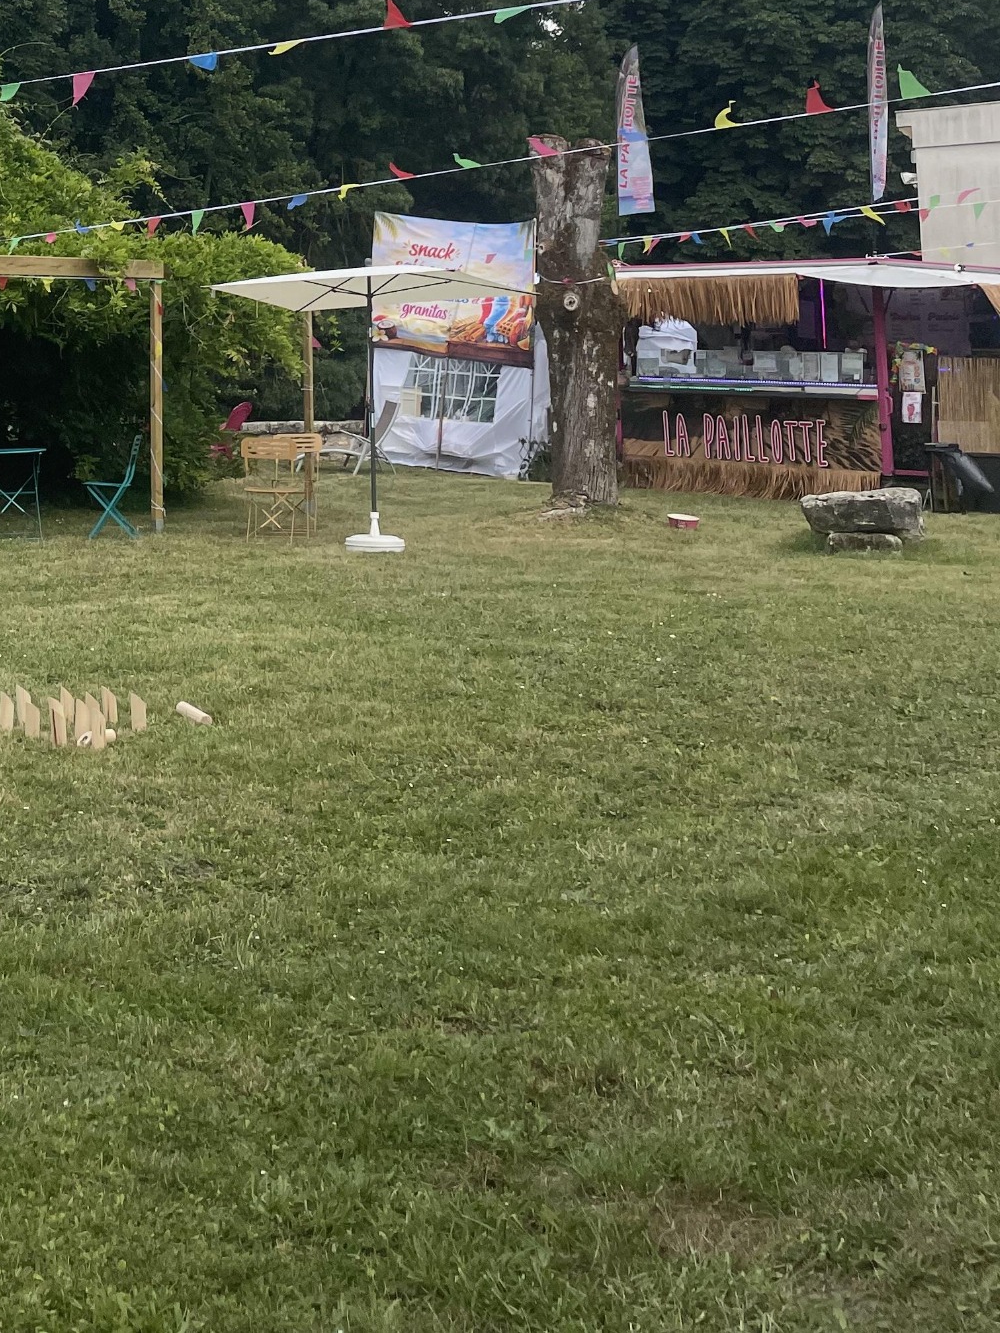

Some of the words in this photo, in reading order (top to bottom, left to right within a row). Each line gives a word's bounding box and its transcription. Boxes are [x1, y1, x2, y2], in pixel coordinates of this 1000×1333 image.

[621, 74, 638, 164] PALOTTE
[619, 169, 629, 189] LA
[408, 242, 456, 260] snack
[400, 303, 449, 320] granitas
[662, 410, 691, 457] LA
[703, 413, 829, 467] PAILLOTTE
